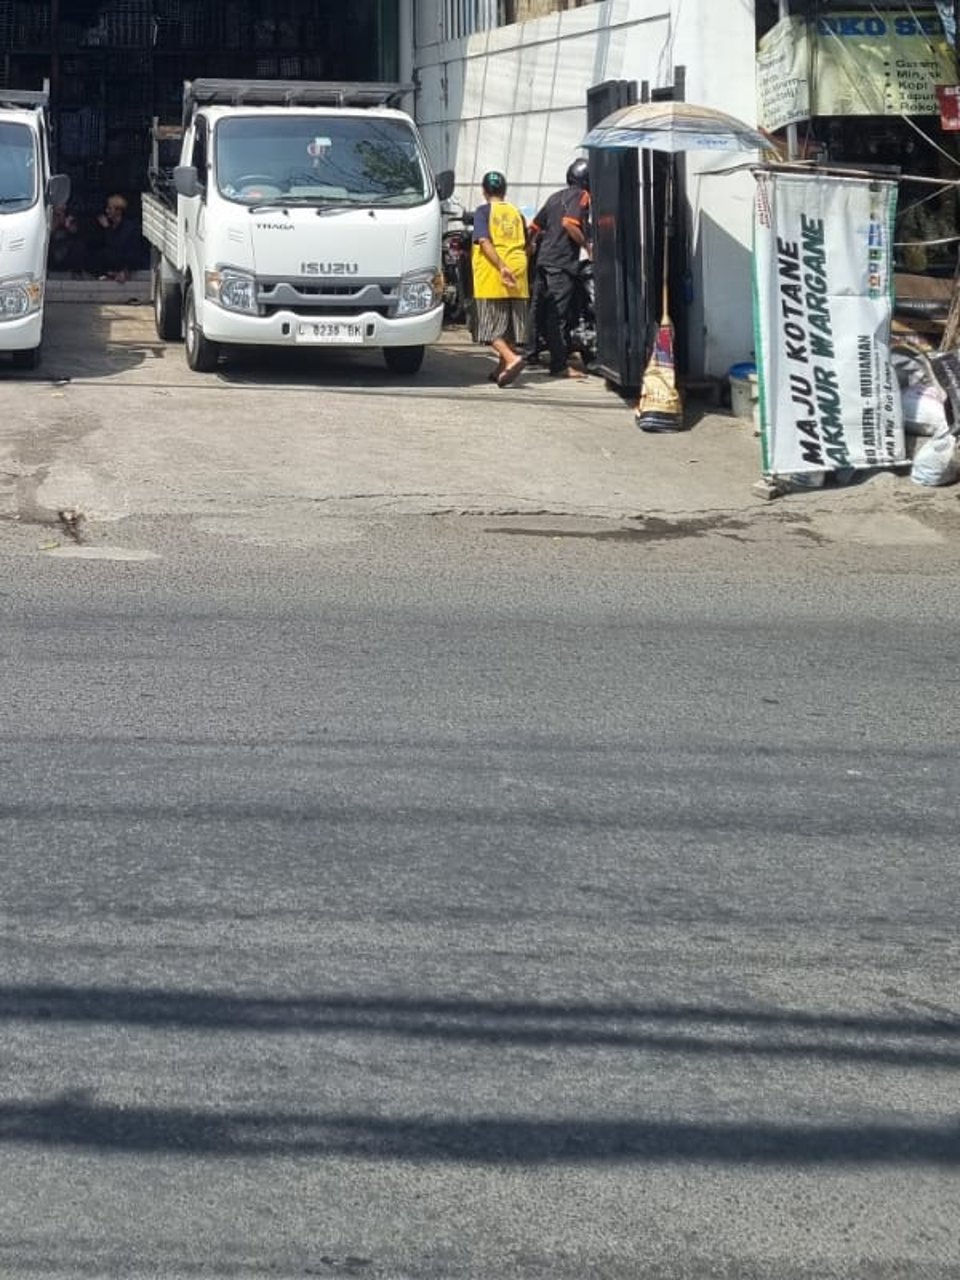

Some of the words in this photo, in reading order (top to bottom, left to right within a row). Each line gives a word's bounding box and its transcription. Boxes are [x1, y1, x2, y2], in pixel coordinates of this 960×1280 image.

[898, 81, 928, 91] Kopi
[300, 262, 359, 275] ISUZU
[776, 236, 809, 363] KOTANE
[801, 213, 835, 359] WARGANE
[789, 373, 825, 466] MAJU
